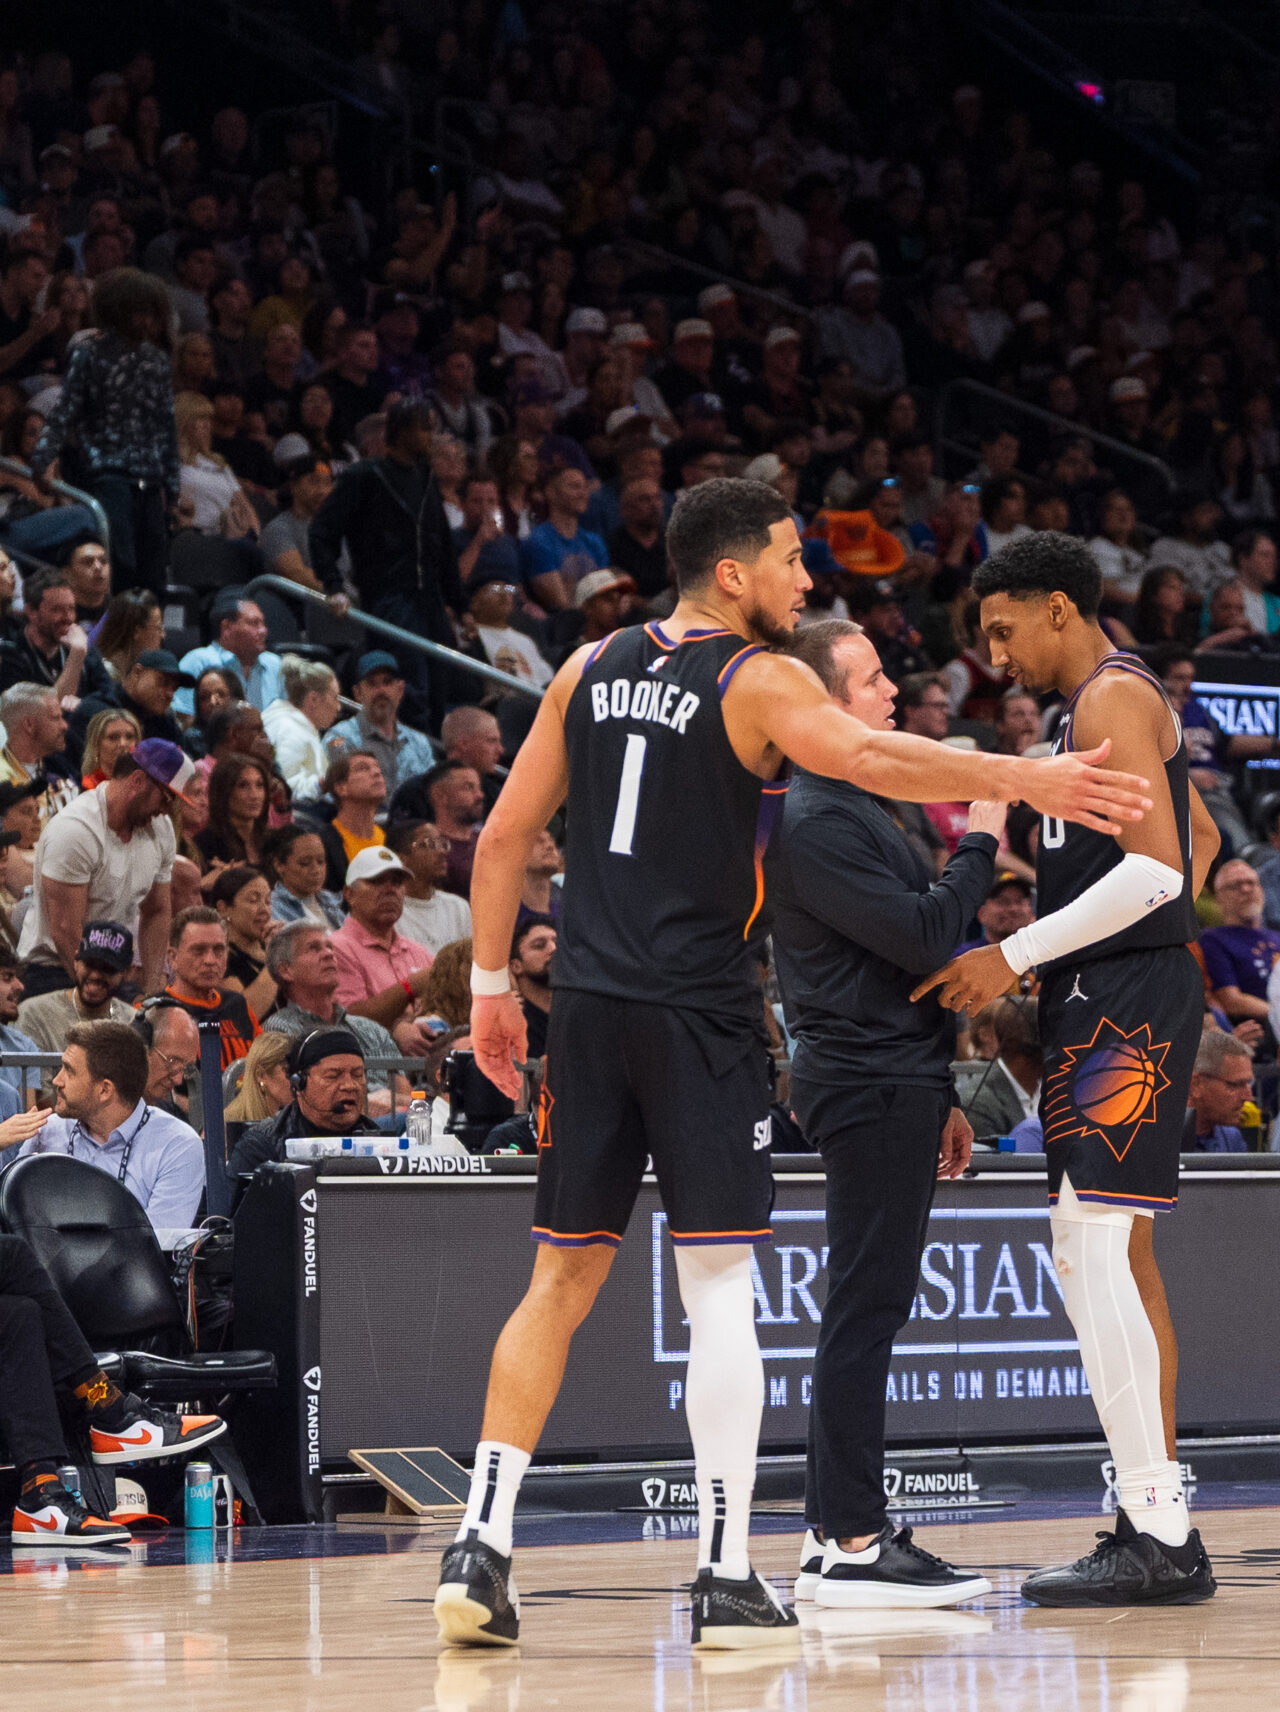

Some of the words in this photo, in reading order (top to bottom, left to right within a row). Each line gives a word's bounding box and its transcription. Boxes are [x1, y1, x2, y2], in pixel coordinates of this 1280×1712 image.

[591, 678, 700, 735] BOOKER
[608, 733, 647, 855] 1
[408, 1156, 492, 1174] FANDUEL
[304, 1217, 317, 1298] FANDUEL
[954, 1370, 983, 1399] ON
[307, 1395, 320, 1475] FANDUEL
[904, 1472, 980, 1492] FANDUEL
